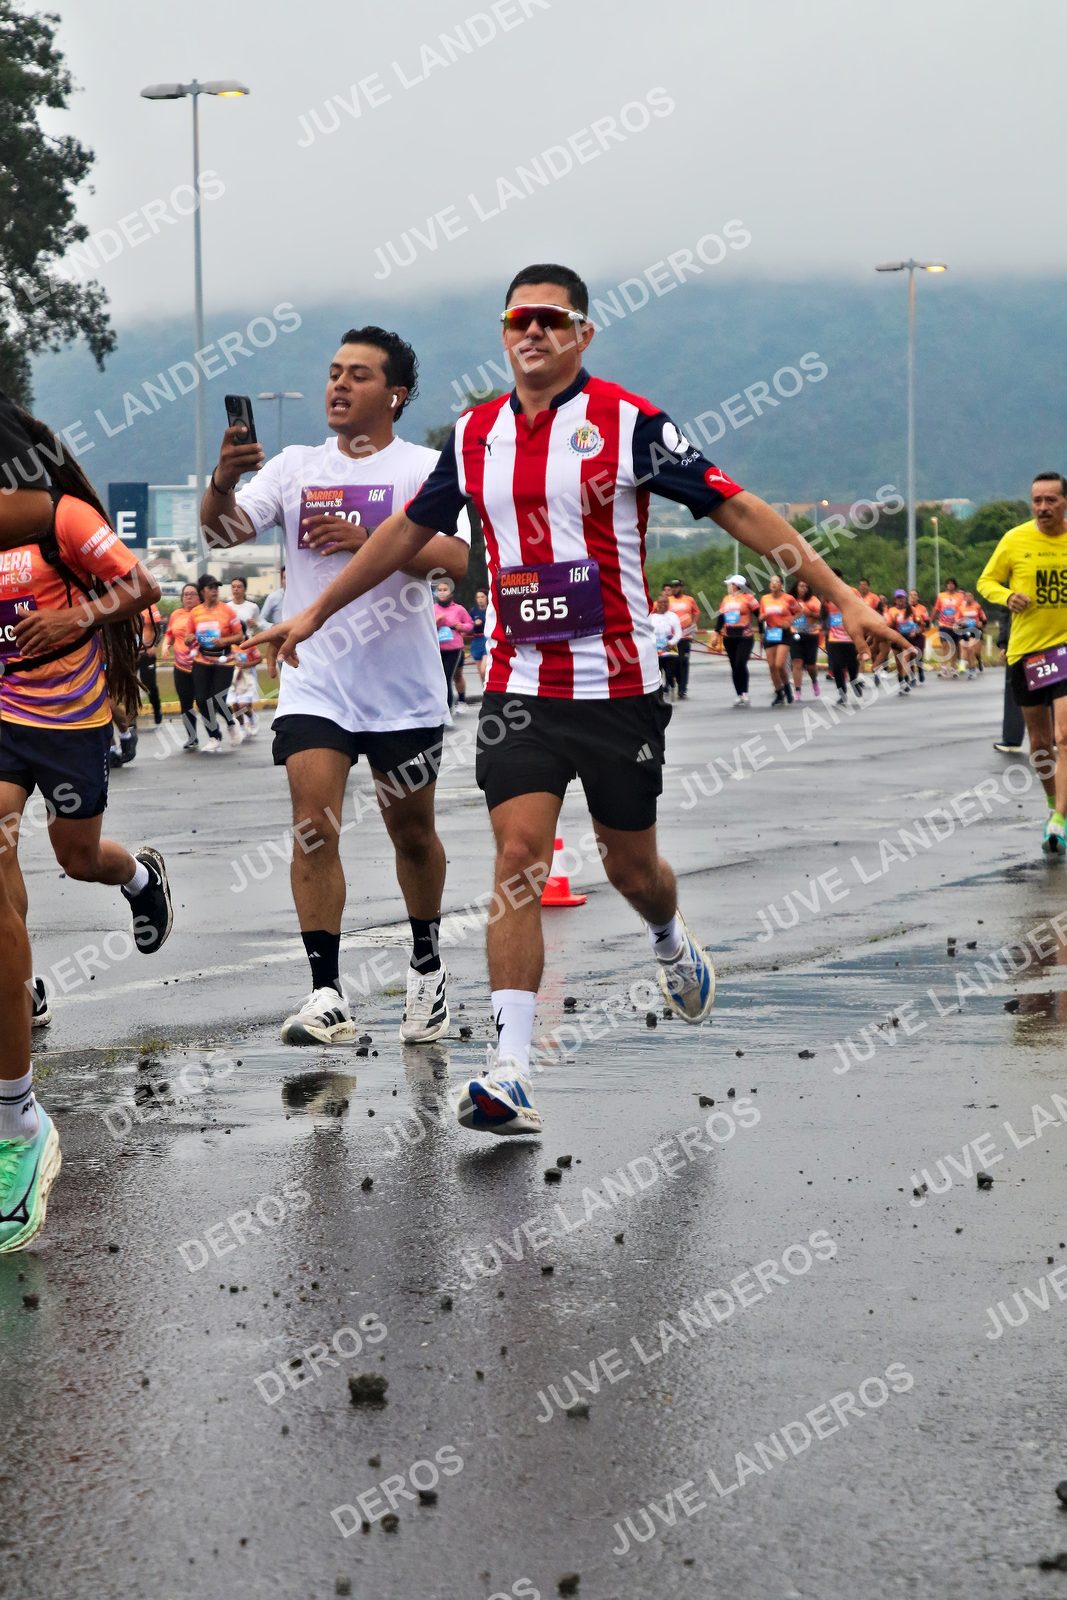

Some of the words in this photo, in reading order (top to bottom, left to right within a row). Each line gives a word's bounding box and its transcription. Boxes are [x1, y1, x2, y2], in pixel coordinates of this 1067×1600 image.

[117, 511, 137, 539] E
[501, 572, 539, 586] CARRERA
[1036, 570, 1067, 587] NAS
[14, 601, 29, 614] 1K
[520, 597, 569, 622] 655
